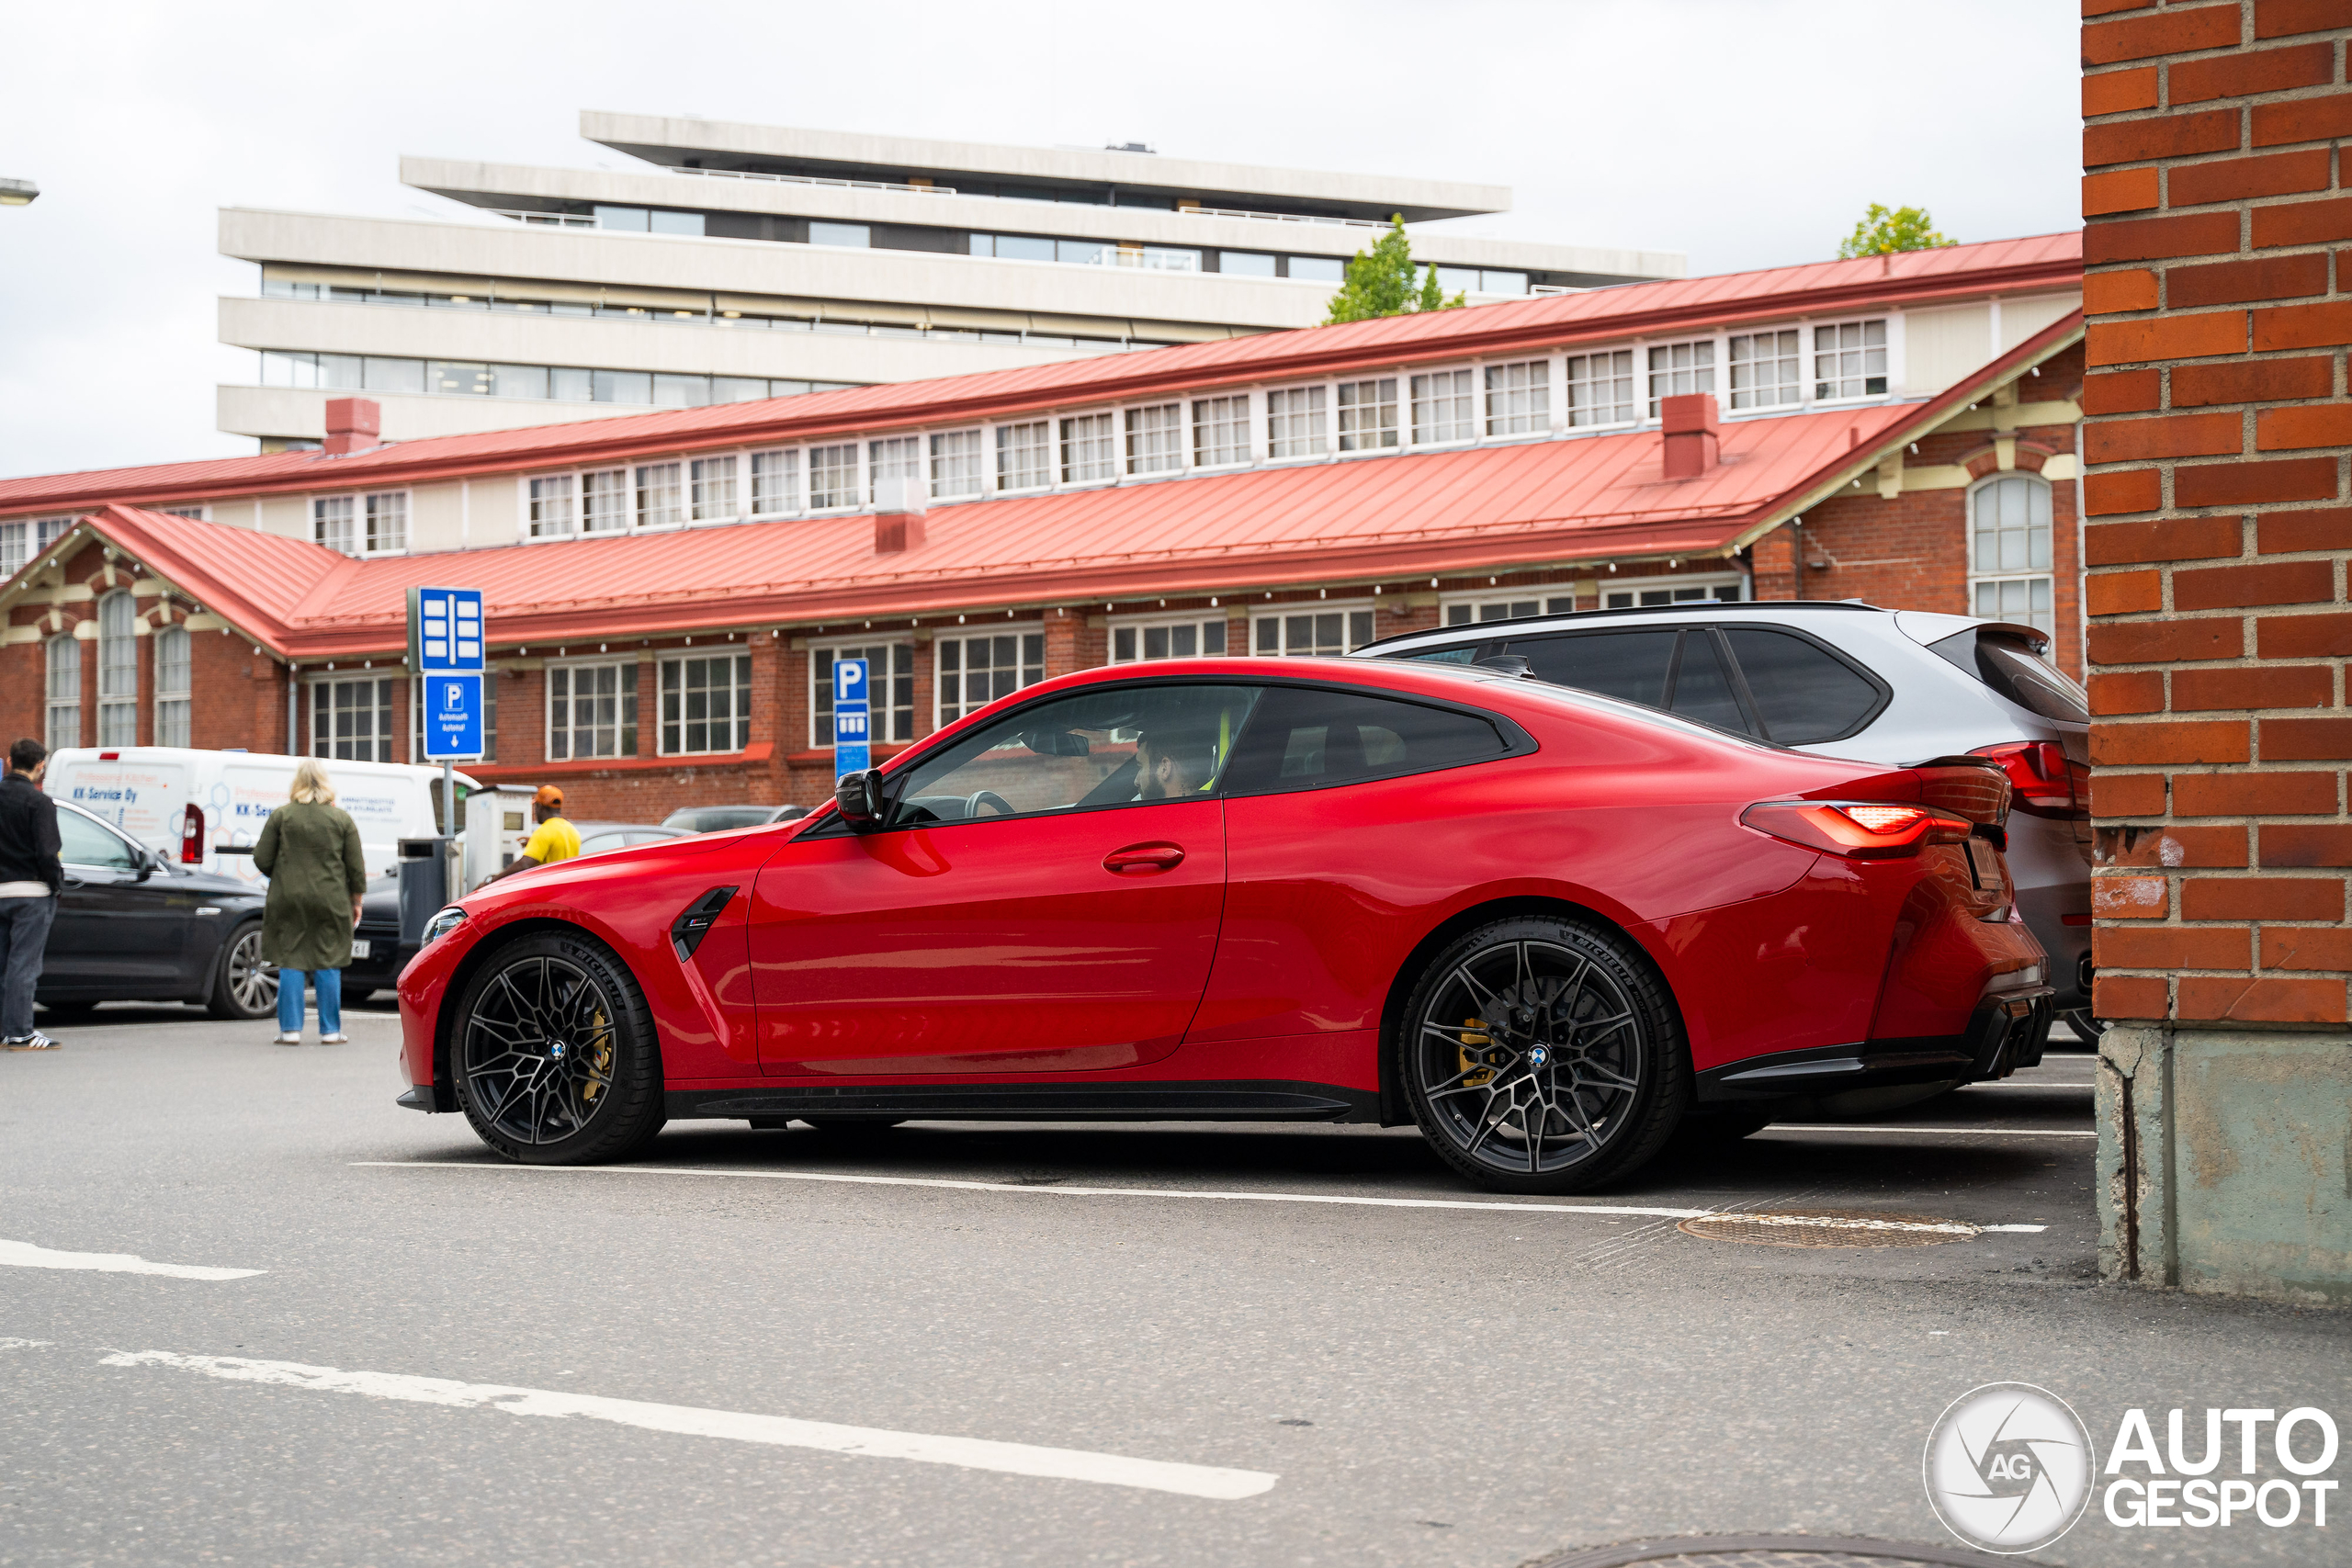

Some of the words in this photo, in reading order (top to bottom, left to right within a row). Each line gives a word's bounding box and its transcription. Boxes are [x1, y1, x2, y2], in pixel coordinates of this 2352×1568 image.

[447, 684, 461, 709] P
[839, 662, 862, 699] P
[73, 786, 122, 801] KK-Service
[125, 787, 138, 805] Oy
[236, 803, 274, 817] KK-Ser
[574, 948, 625, 1008] MICHELIN
[1576, 936, 1634, 987] MICHELIN
[1632, 989, 1645, 1011] PILOT
[1424, 1124, 1480, 1175] MICHELIN
